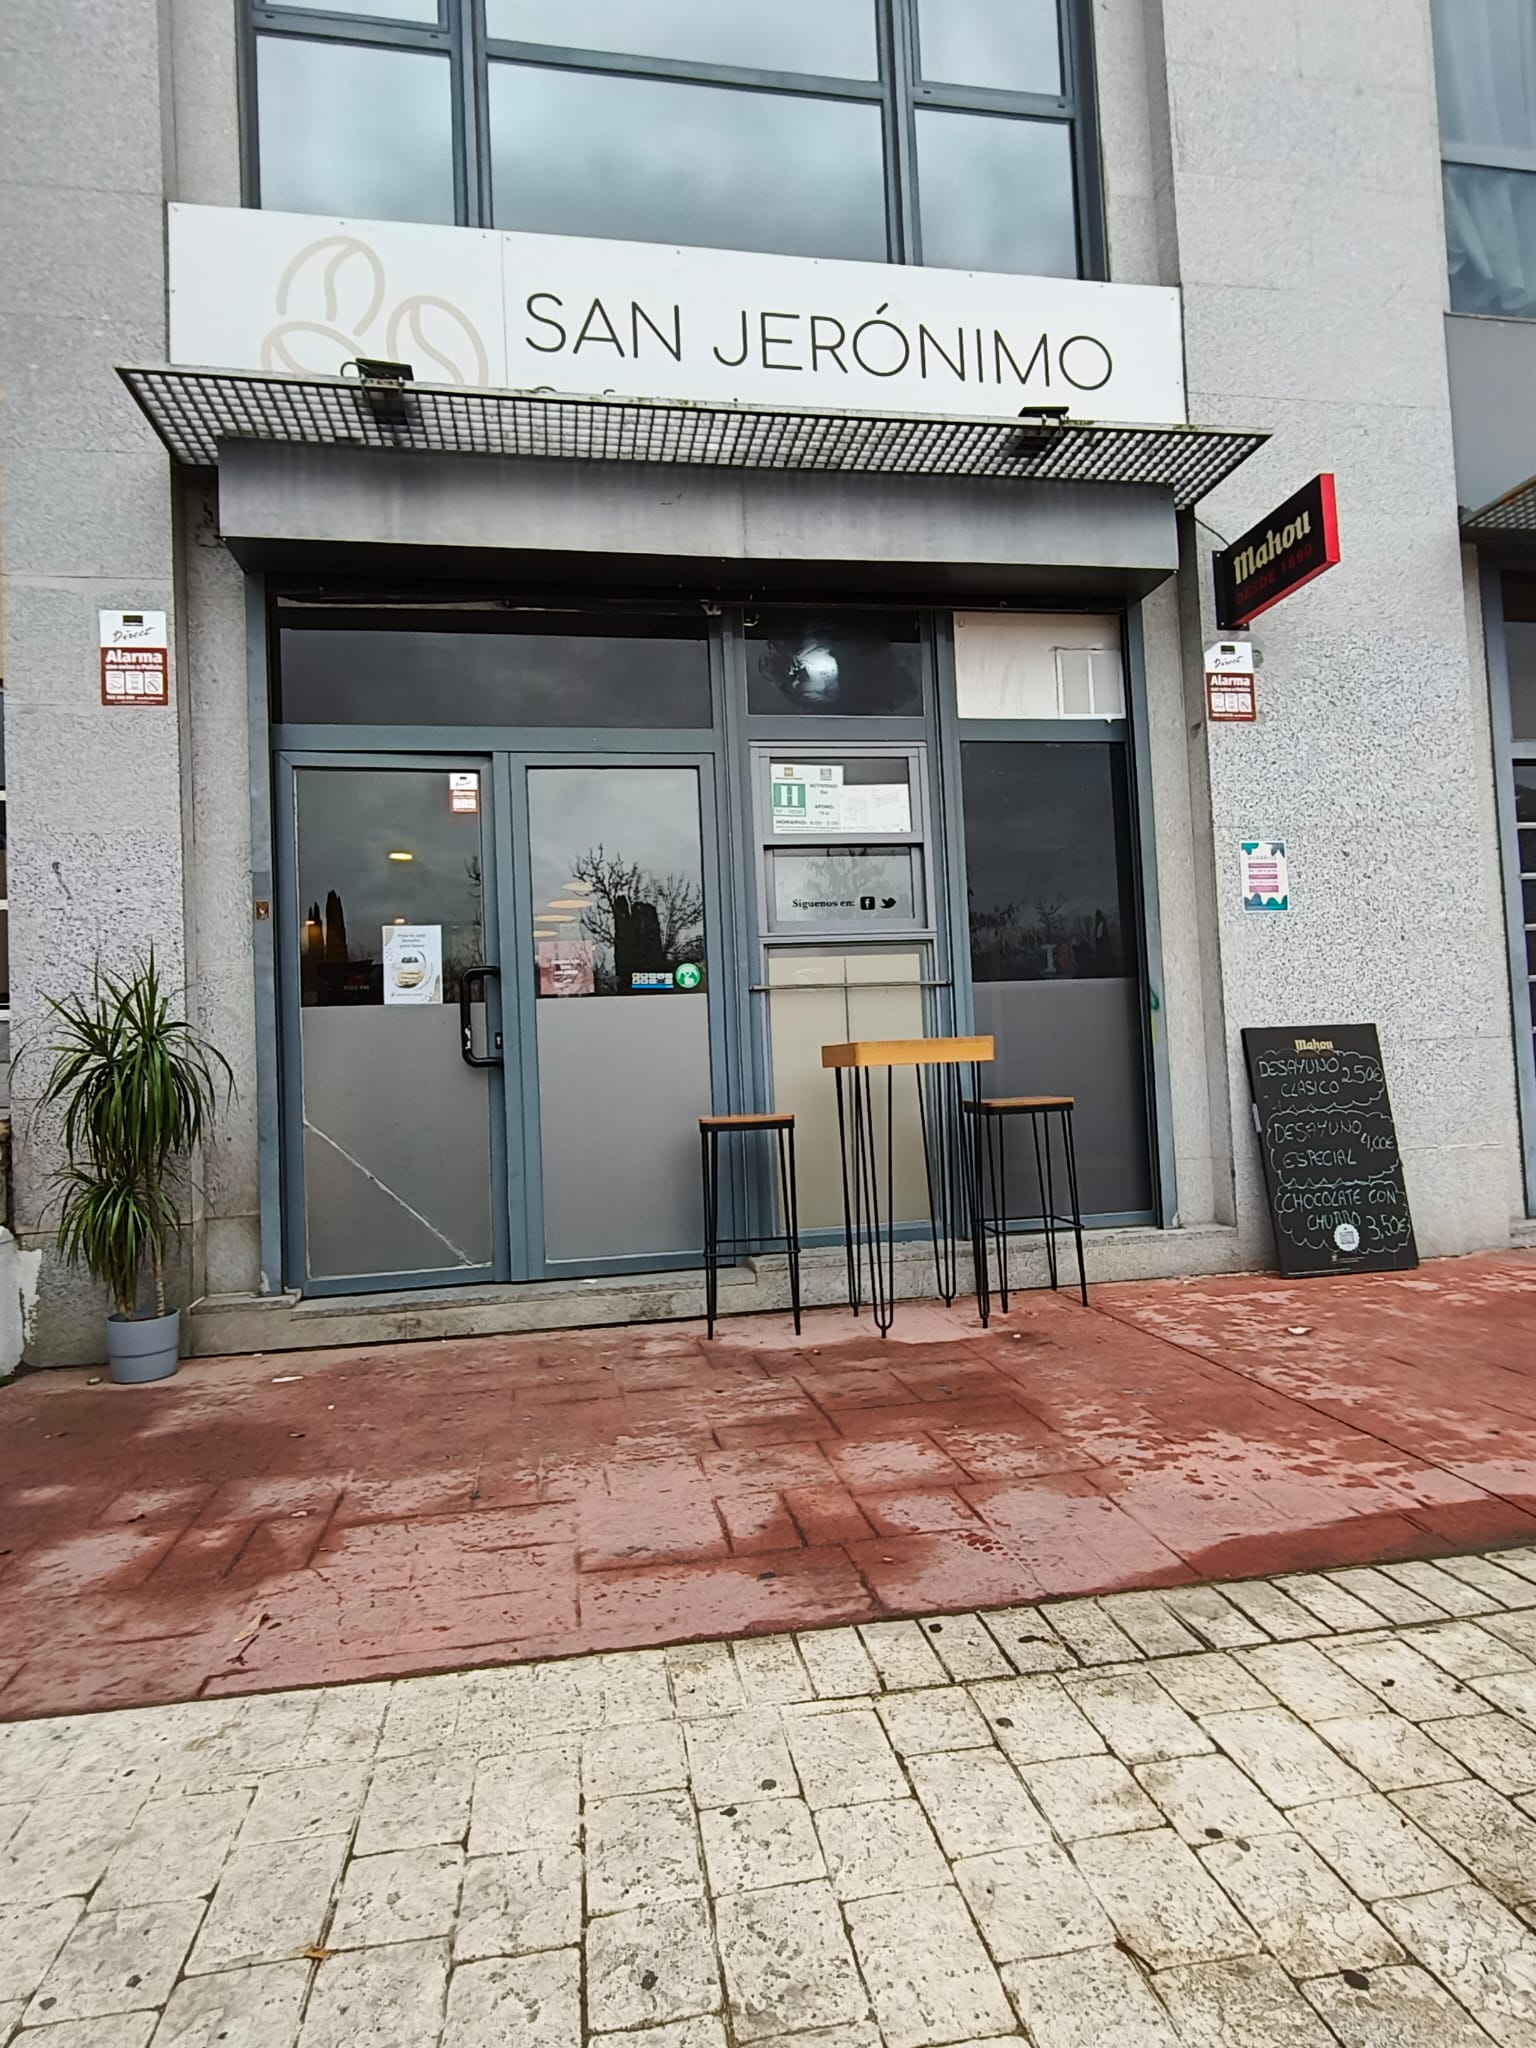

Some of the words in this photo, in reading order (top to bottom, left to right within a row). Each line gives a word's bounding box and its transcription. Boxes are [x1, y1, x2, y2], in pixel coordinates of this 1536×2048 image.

[526, 292, 681, 362] SAN
[712, 302, 1113, 391] JERÓNIMO
[1233, 510, 1312, 585] Mahou
[1236, 568, 1276, 605] DESDE
[1281, 543, 1313, 575] 1890
[105, 649, 163, 663] Alarma
[1210, 674, 1251, 687] Alarma
[780, 784, 800, 807] H
[1294, 1038, 1335, 1053] Mahou
[1258, 1056, 1340, 1078] DESAYUNO
[1280, 1080, 1340, 1098] CLASICO
[1274, 1119, 1363, 1144] DESAYUNO
[1282, 1148, 1358, 1169] ESPECIAL
[1281, 1188, 1362, 1213] CHOCOLATE
[1368, 1188, 1397, 1205] CON
